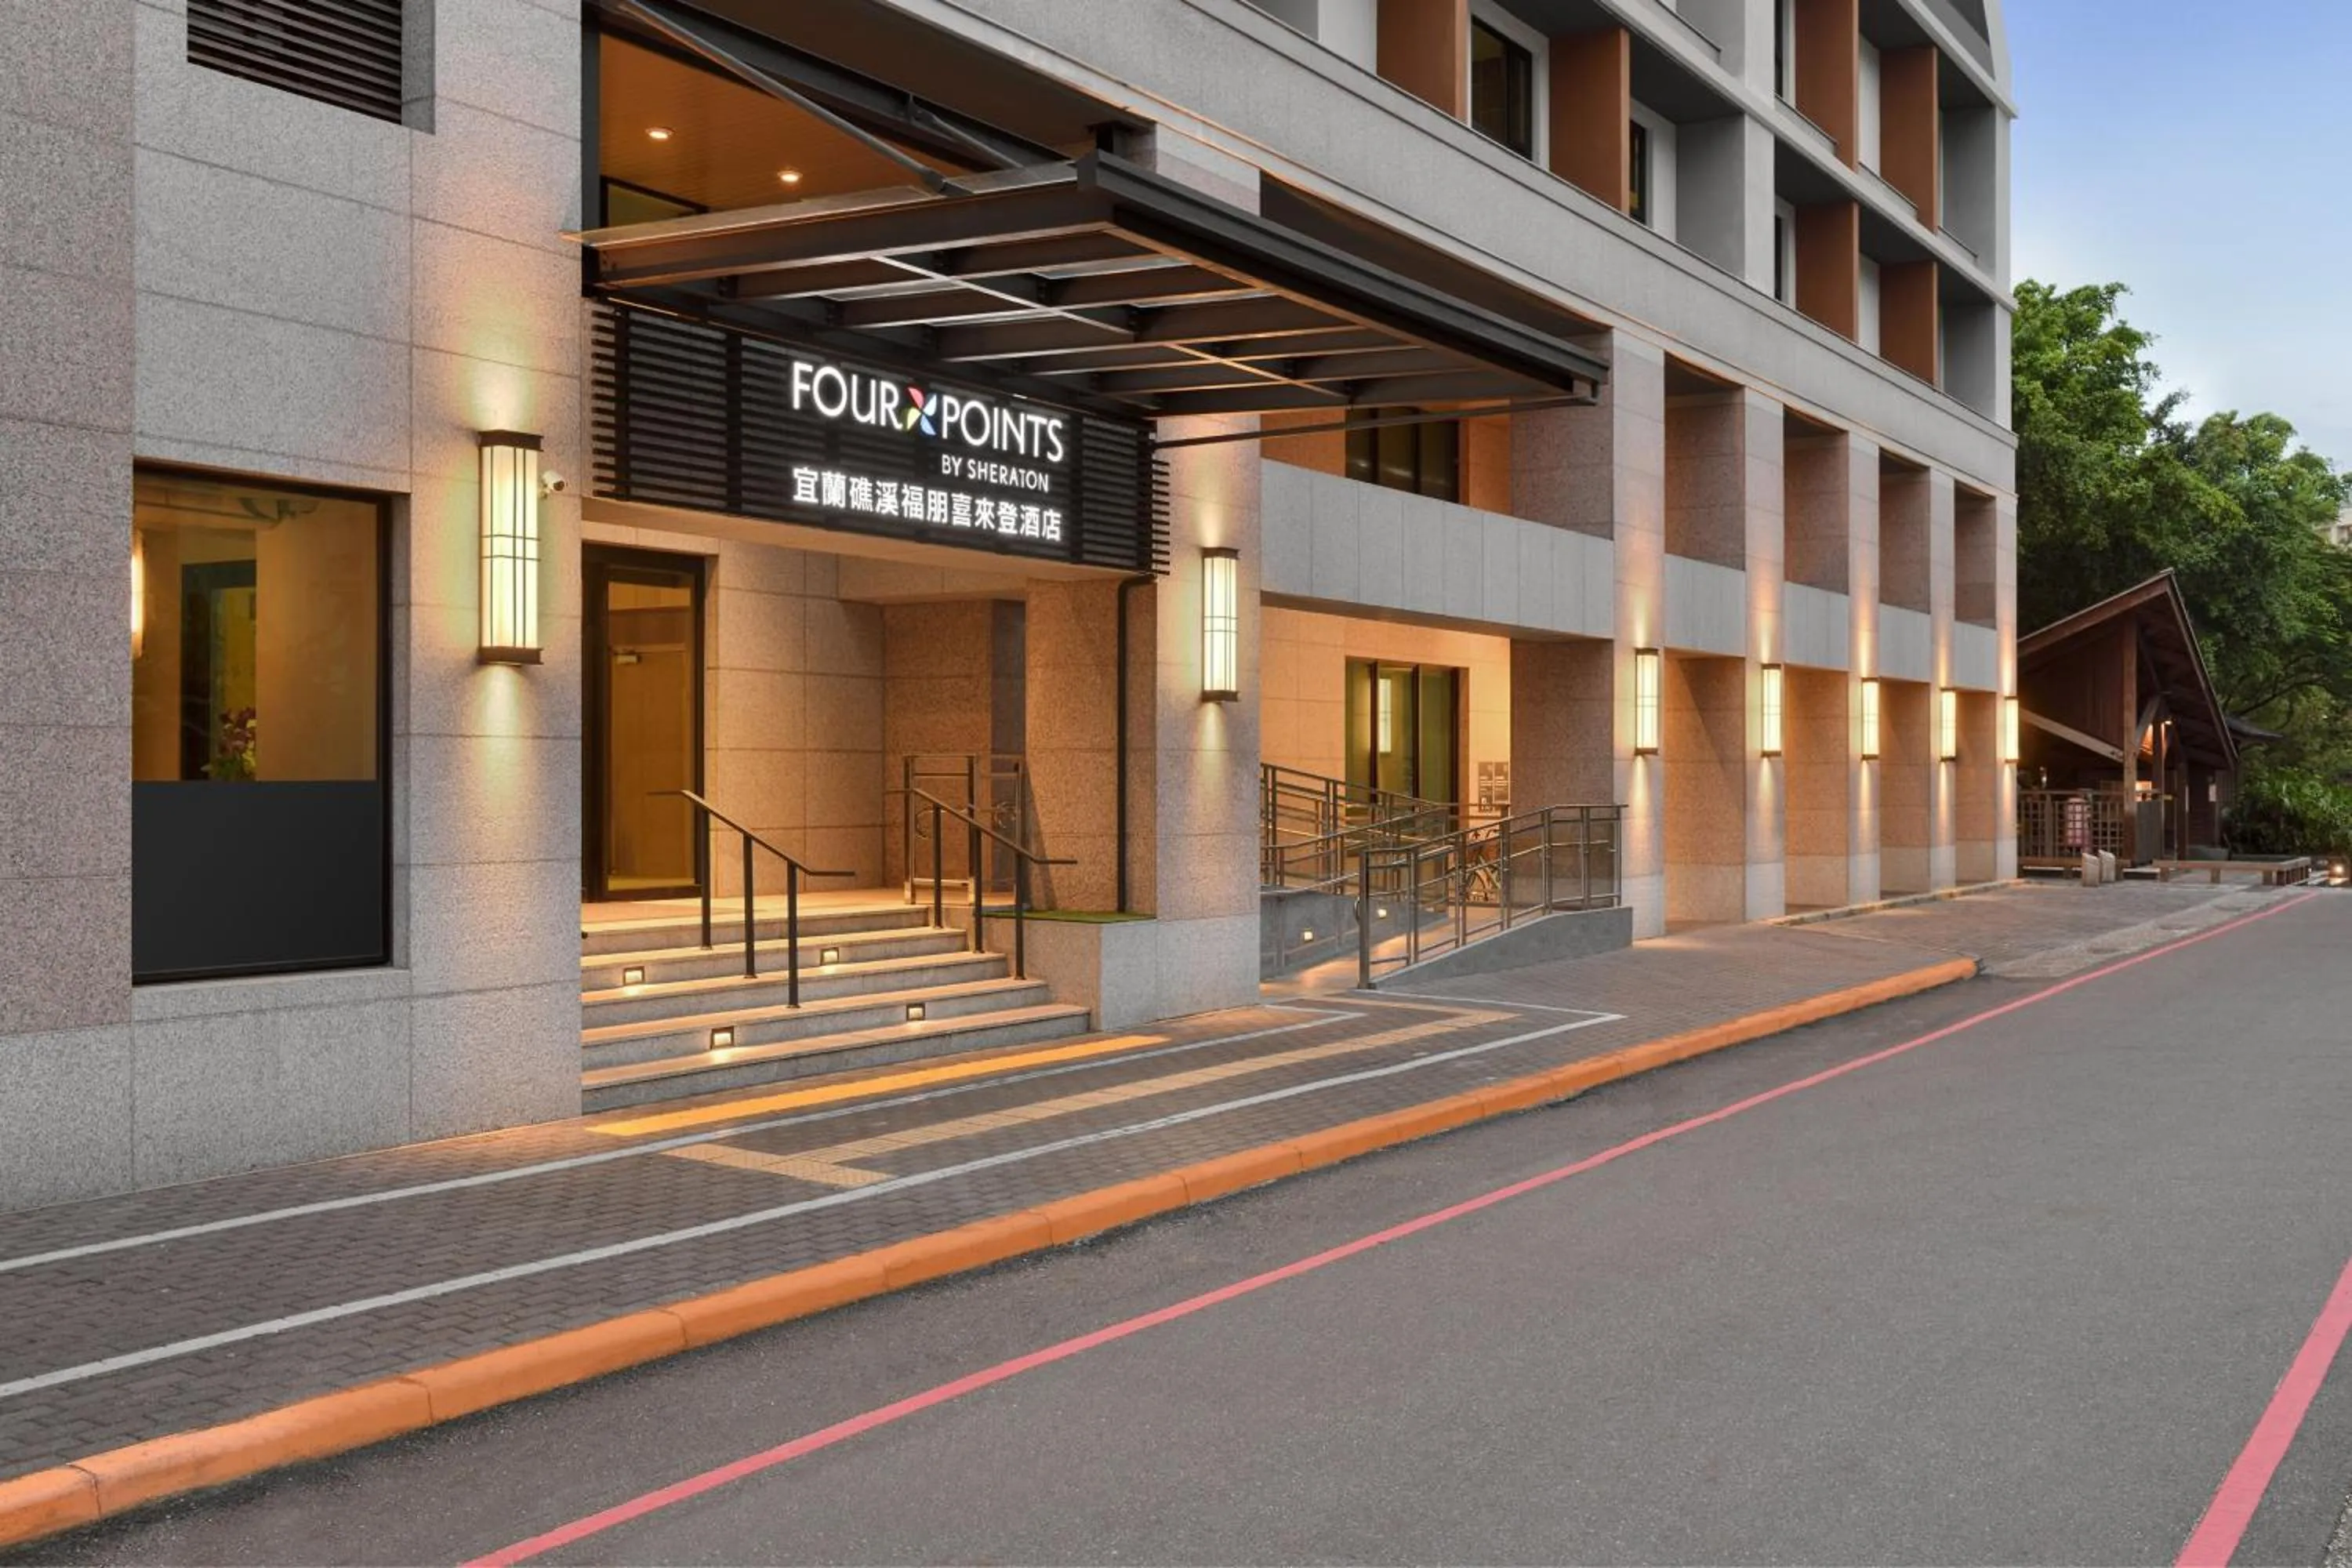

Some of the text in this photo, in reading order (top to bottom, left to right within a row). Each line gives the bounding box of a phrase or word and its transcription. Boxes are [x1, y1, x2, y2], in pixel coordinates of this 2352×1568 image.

[792, 361, 1064, 462] FOUR POINTS
[793, 467, 1062, 542] 宜蘭礁溪福朋喜來登酒店
[942, 455, 1049, 493] BY SHERATON
